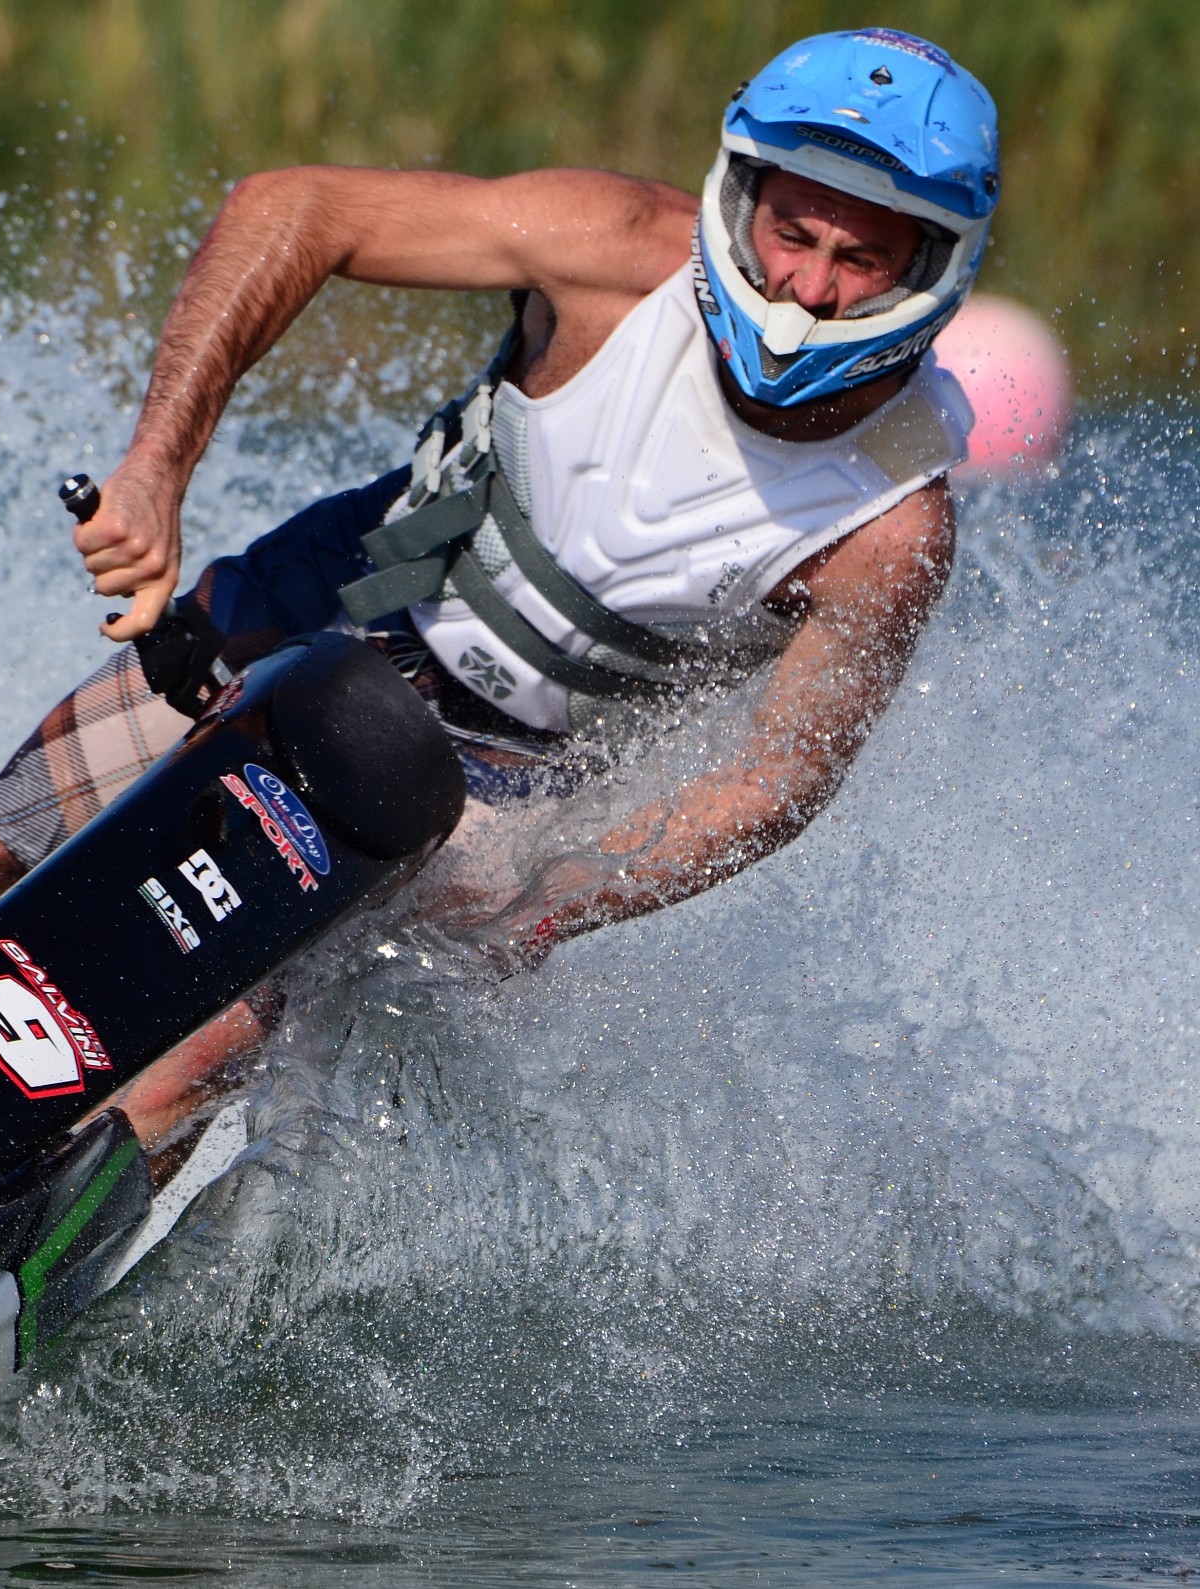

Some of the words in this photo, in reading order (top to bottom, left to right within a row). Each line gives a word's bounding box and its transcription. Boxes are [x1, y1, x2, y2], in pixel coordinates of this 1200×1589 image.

[795, 125, 911, 174] SCORPION
[219, 774, 319, 892] SPORT
[259, 774, 290, 812] One
[290, 813, 321, 858] Day
[178, 848, 242, 922] DC
[0, 941, 103, 1067] SALVINI
